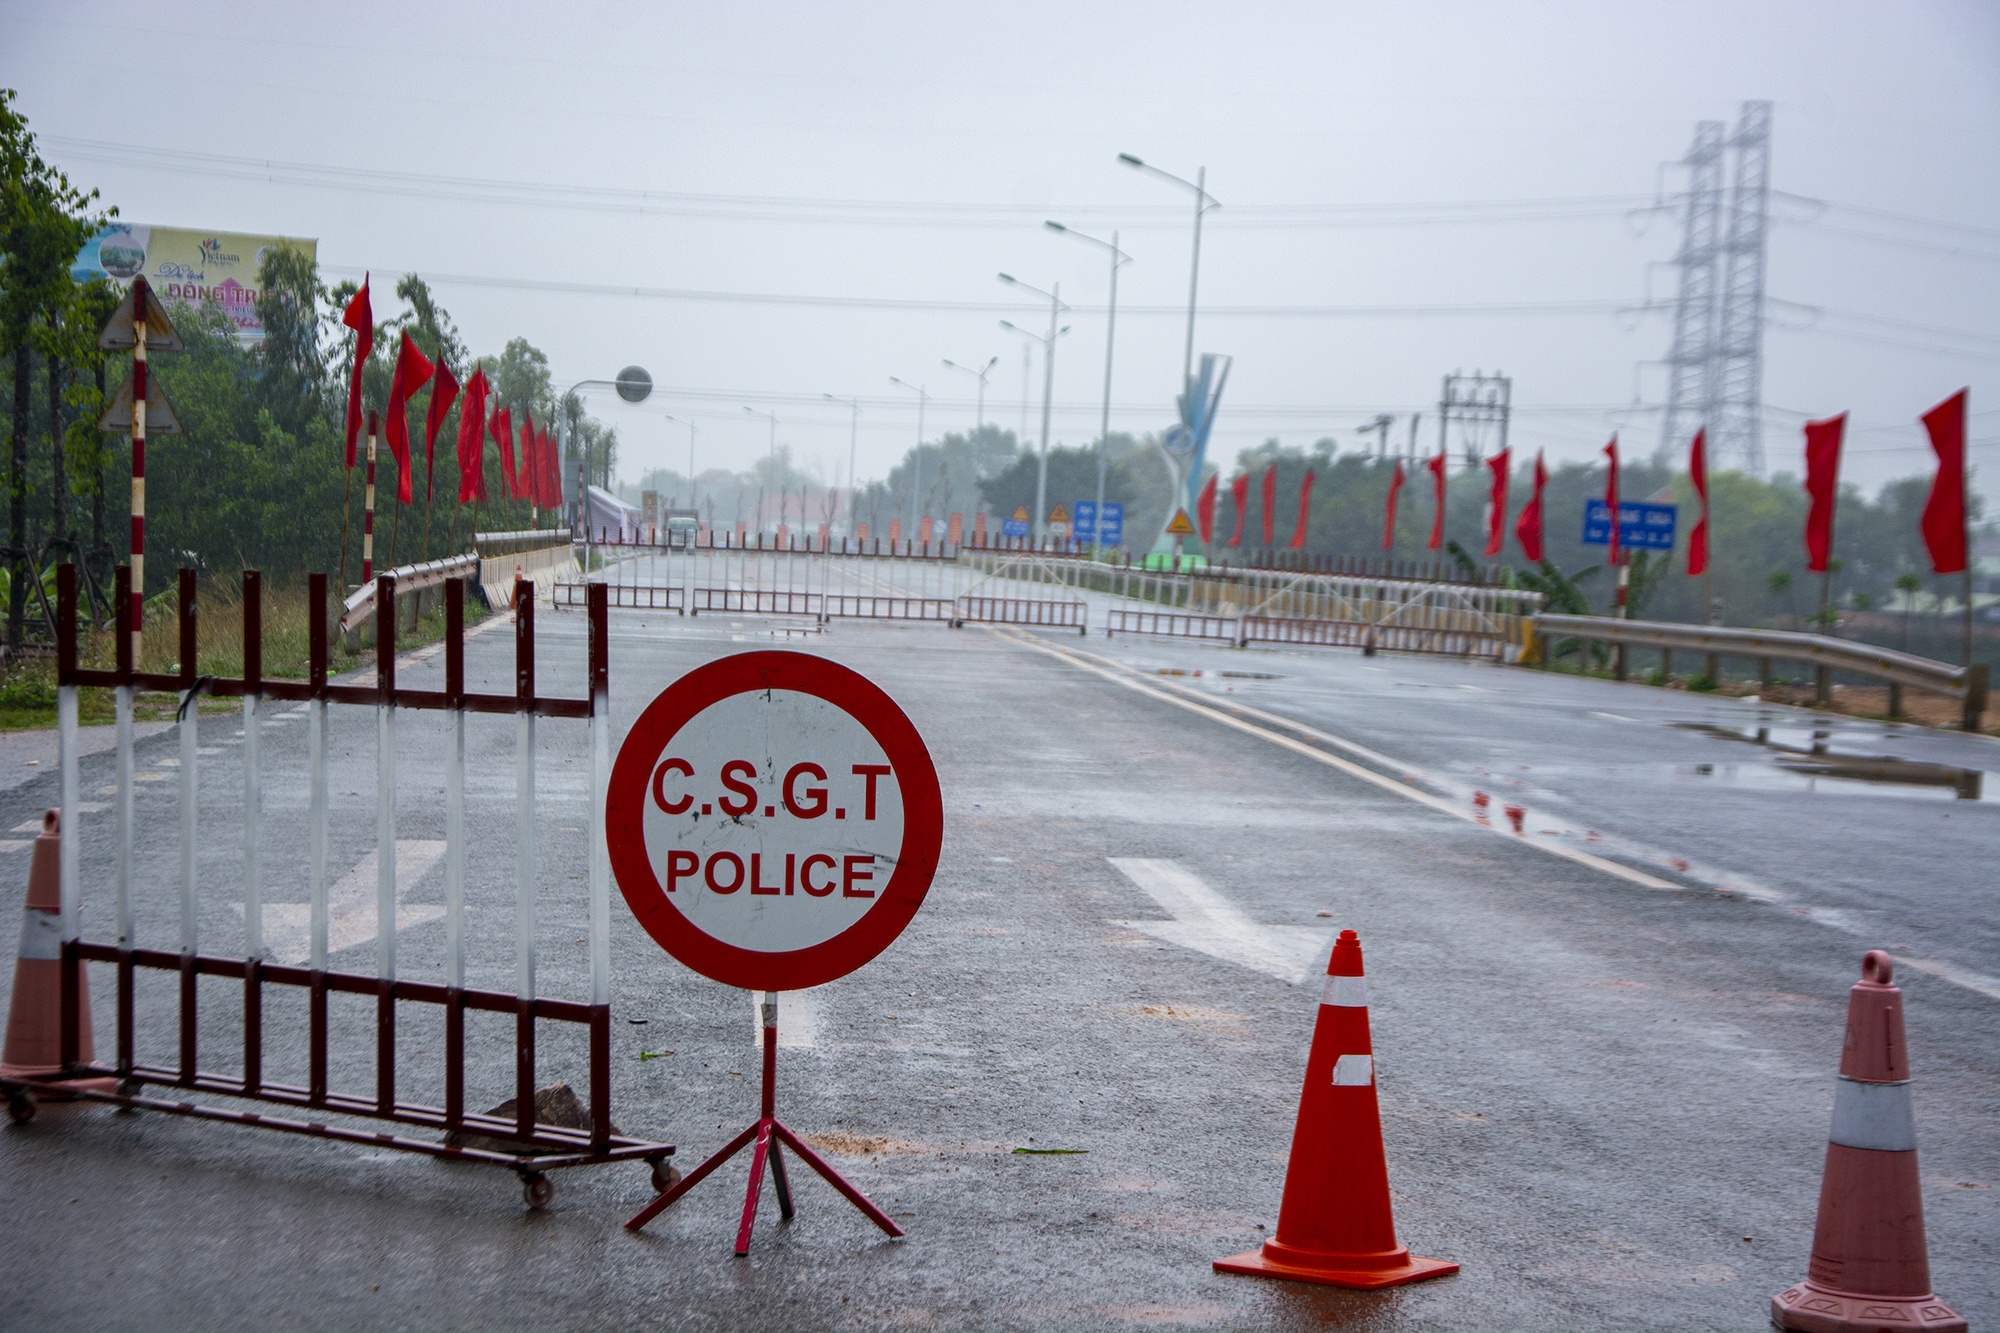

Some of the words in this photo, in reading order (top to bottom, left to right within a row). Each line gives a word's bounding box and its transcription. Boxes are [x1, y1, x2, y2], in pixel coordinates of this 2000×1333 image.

[197, 244, 240, 264] Vietnam
[652, 757, 891, 821] C.S.G.T
[666, 850, 875, 898] POLICE
